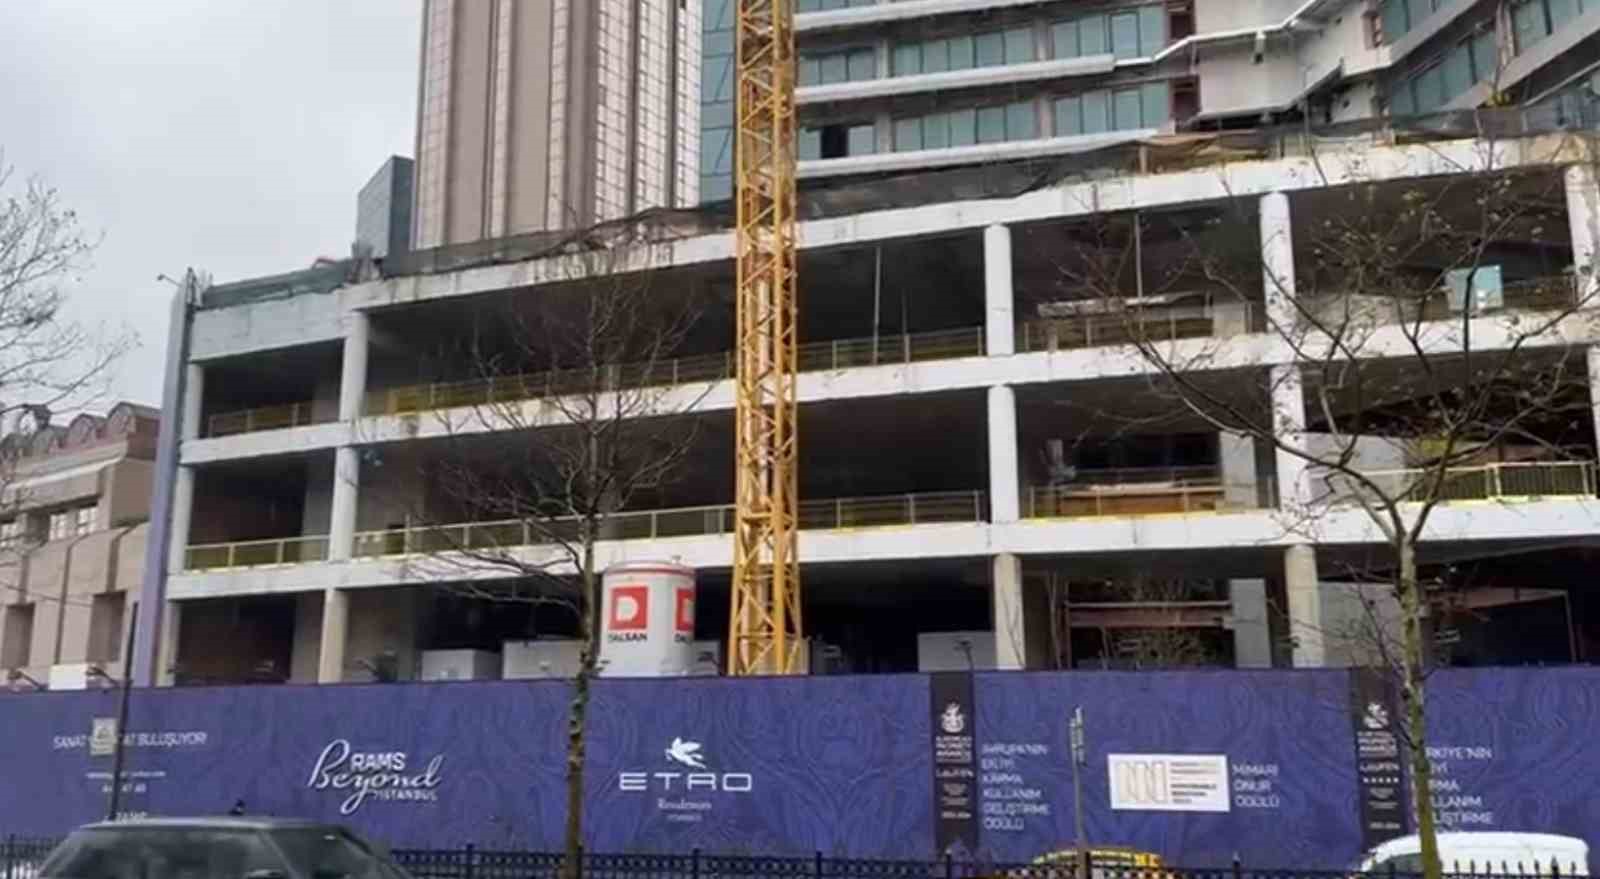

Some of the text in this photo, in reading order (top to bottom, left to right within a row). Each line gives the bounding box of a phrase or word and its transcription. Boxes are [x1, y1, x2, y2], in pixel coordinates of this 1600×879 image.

[351, 752, 406, 771] RAMS
[307, 739, 444, 815] Beyond
[619, 772, 753, 791] ETRO
